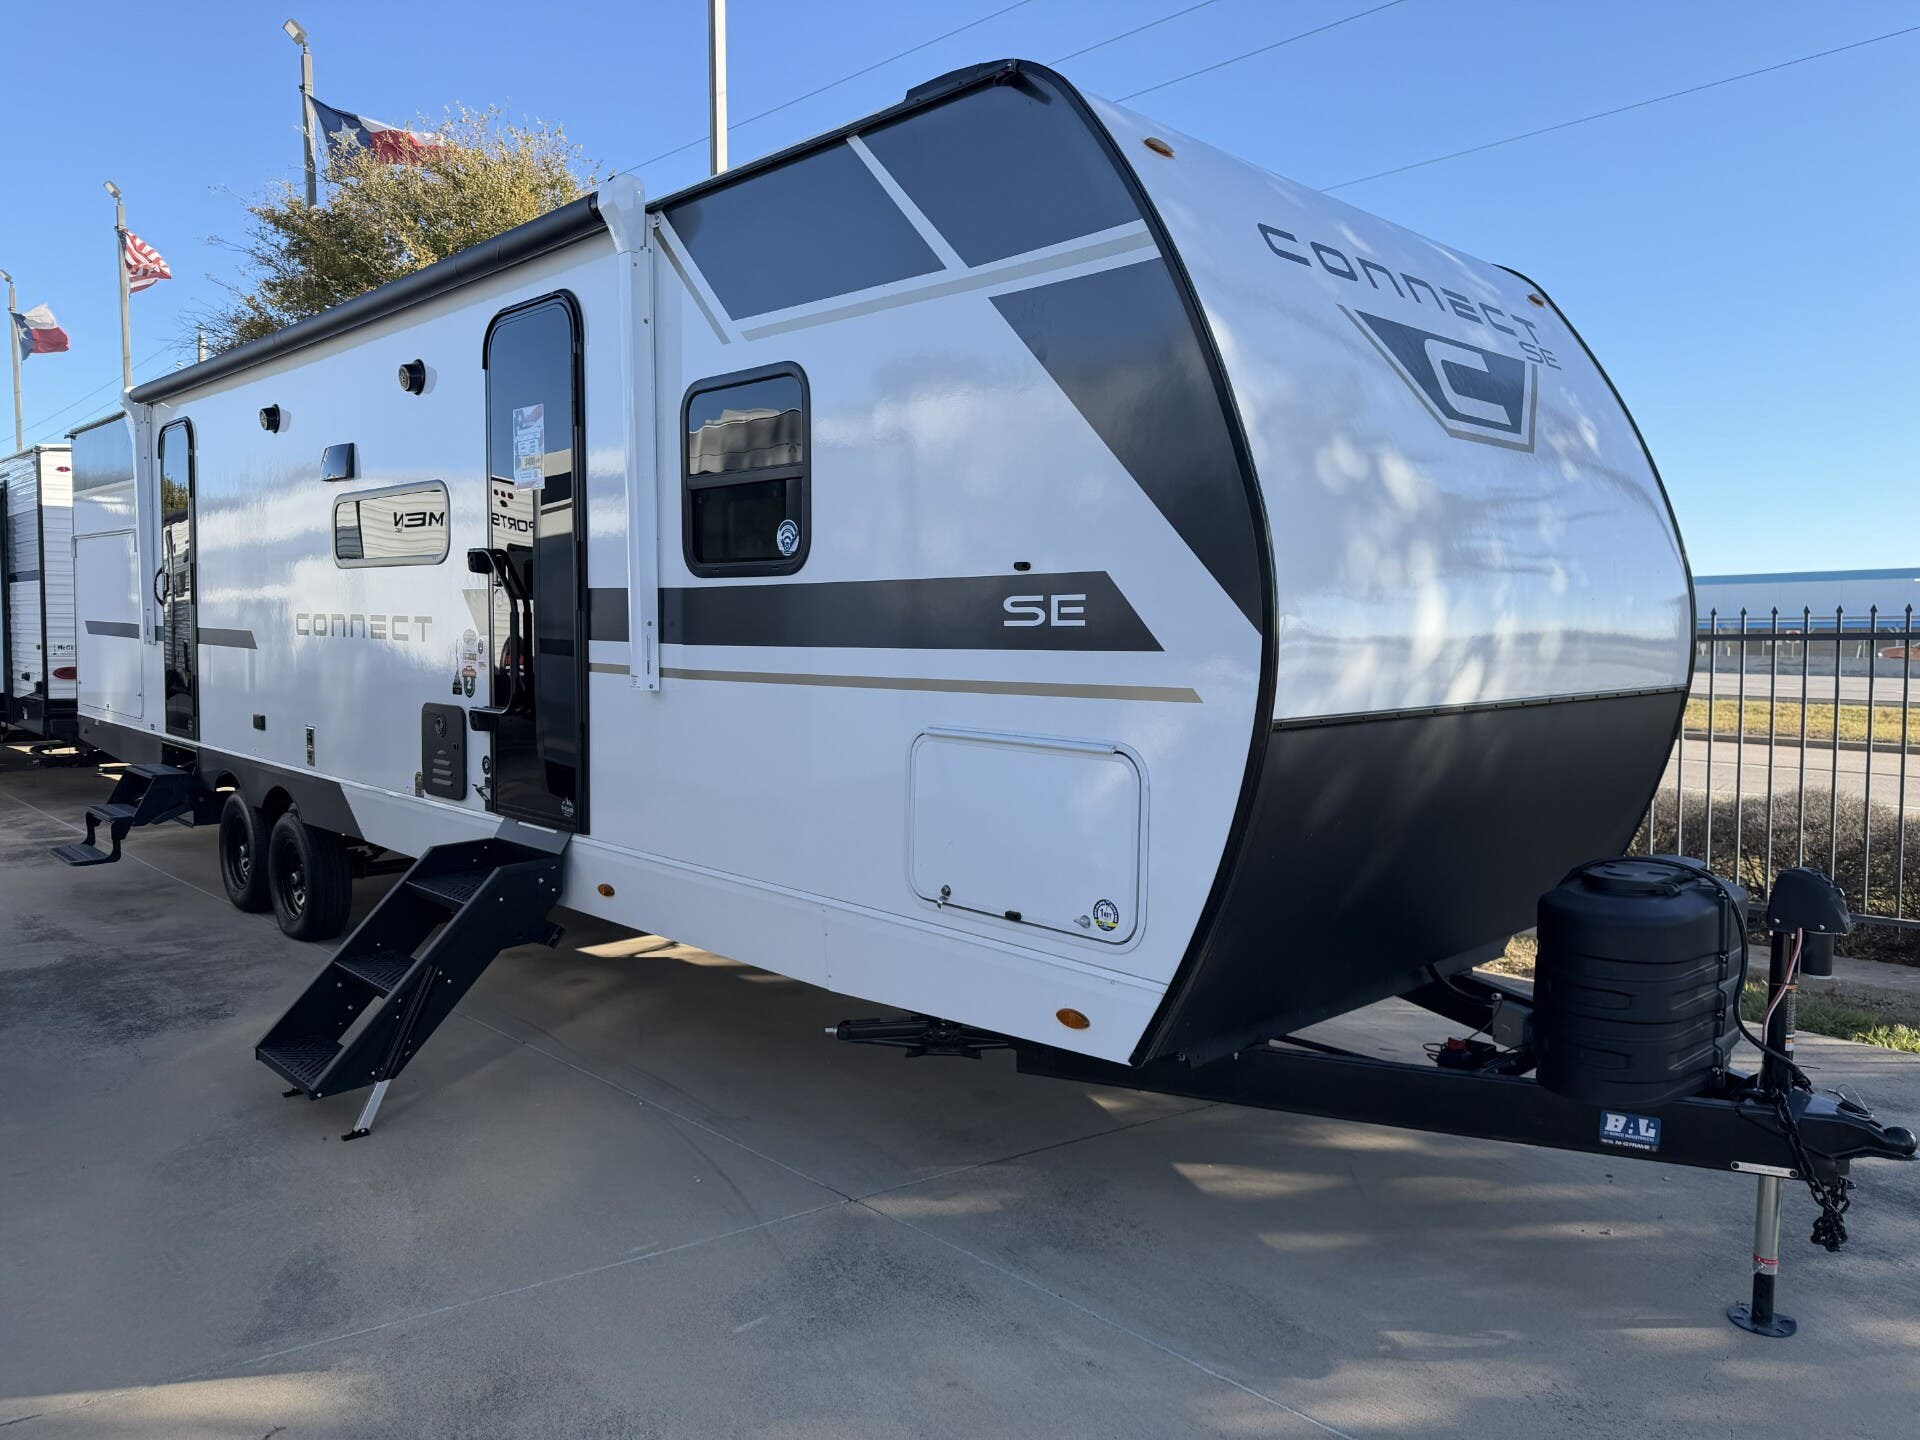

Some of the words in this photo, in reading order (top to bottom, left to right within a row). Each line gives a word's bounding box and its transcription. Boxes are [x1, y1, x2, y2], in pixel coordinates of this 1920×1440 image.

[1257, 222, 1536, 344] CONNECT
[1518, 340, 1562, 371] SE
[1003, 593, 1086, 628] SE
[296, 612, 433, 643] CONNECT
[1604, 1113, 1656, 1137] BAL
